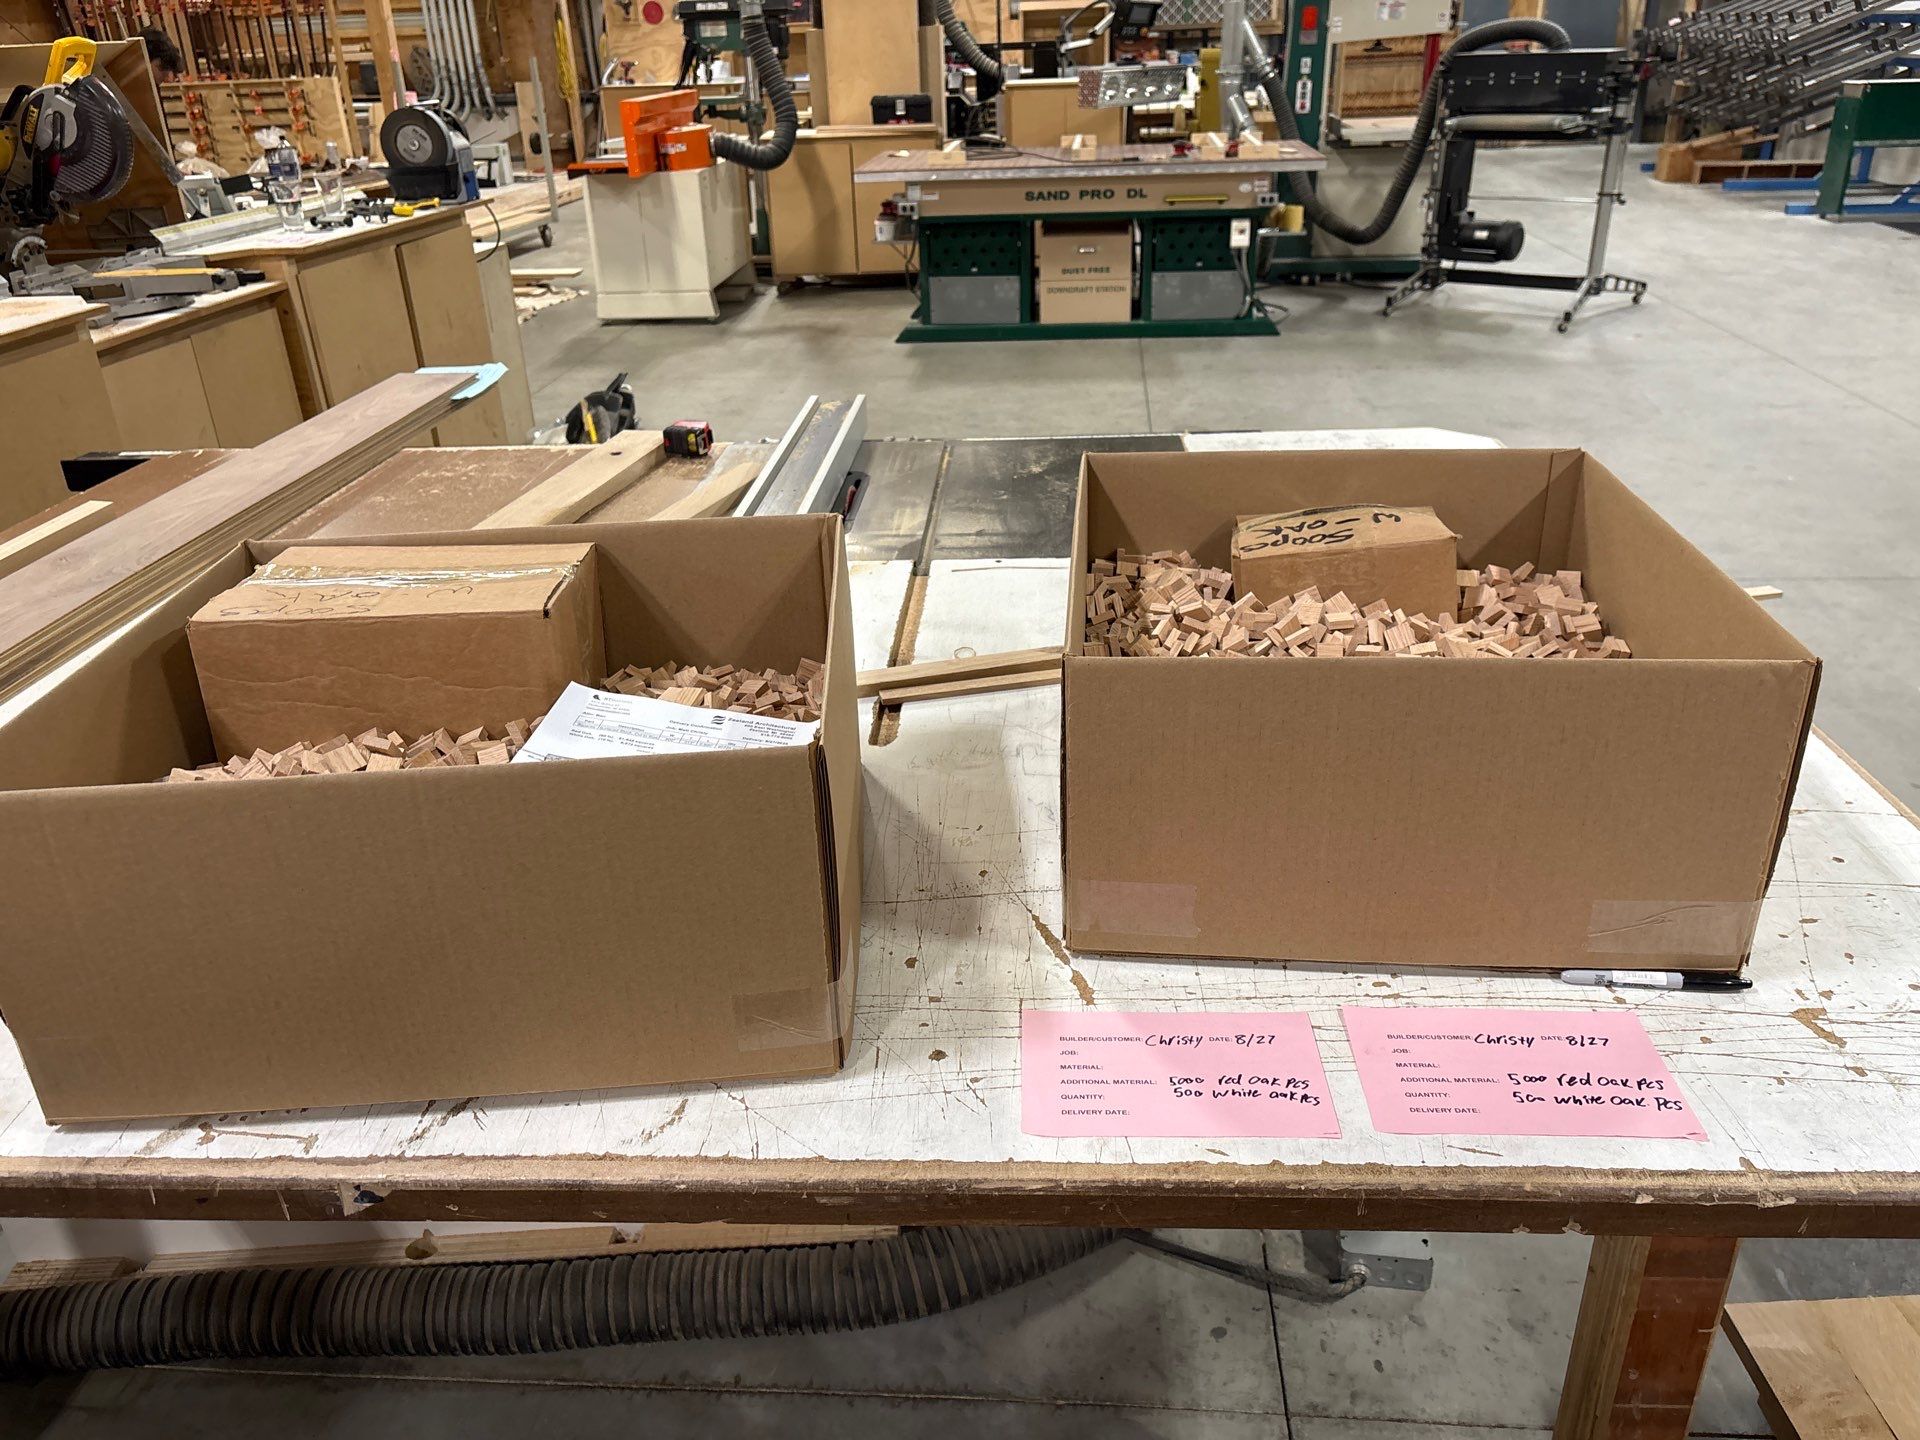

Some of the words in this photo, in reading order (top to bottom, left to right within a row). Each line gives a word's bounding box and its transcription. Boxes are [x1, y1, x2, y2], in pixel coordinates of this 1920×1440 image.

[1025, 190, 1070, 201] SAND
[1079, 189, 1115, 200] PRO
[1127, 188, 1148, 199] DL
[1088, 266, 1110, 275] FREE
[755, 720, 797, 731] Architectural
[1144, 1034, 1203, 1049] Christy
[1234, 1034, 1276, 1046] 8/27
[1474, 1033, 1535, 1048] Christy
[1173, 1087, 1203, 1098] 500
